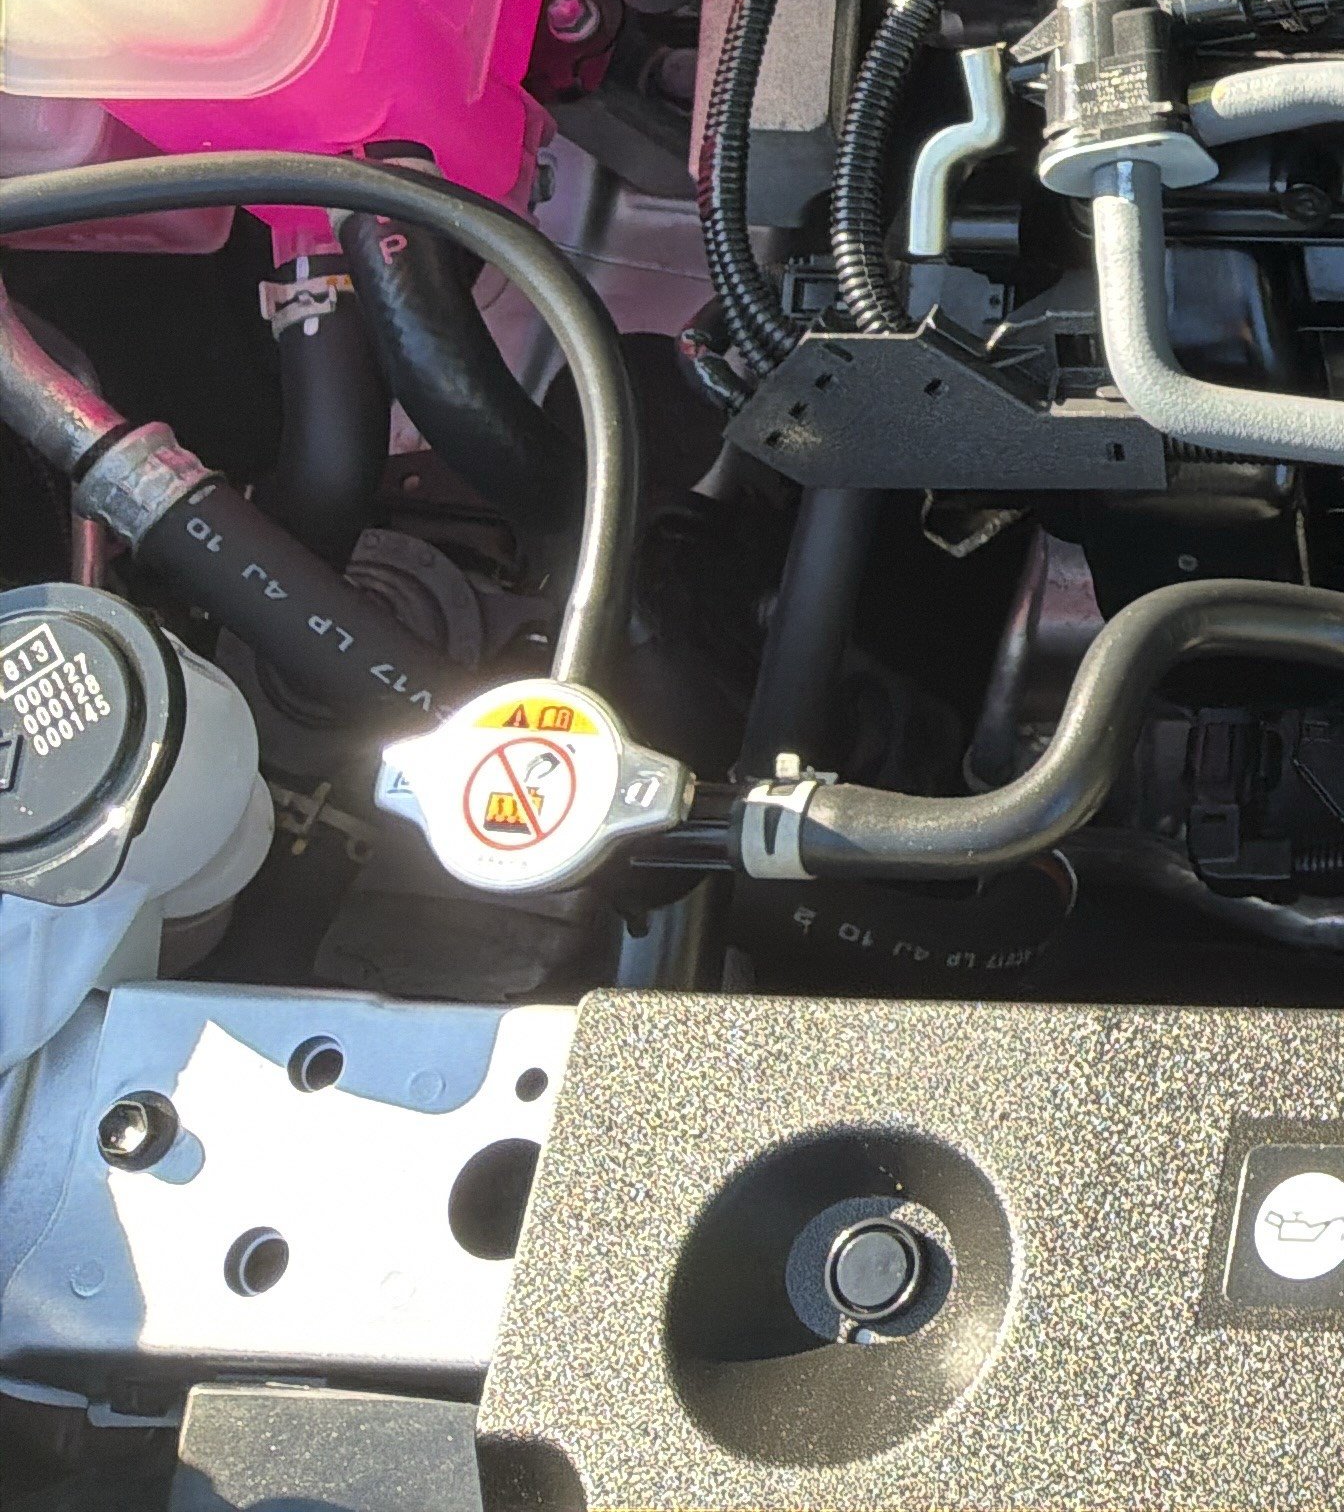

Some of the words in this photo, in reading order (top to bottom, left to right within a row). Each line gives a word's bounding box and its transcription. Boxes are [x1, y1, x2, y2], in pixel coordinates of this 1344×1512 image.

[241, 563, 289, 600] 4J
[308, 614, 354, 652] LP
[14, 652, 88, 714] 000127
[23, 674, 101, 735] 000128
[33, 694, 111, 756] 000145
